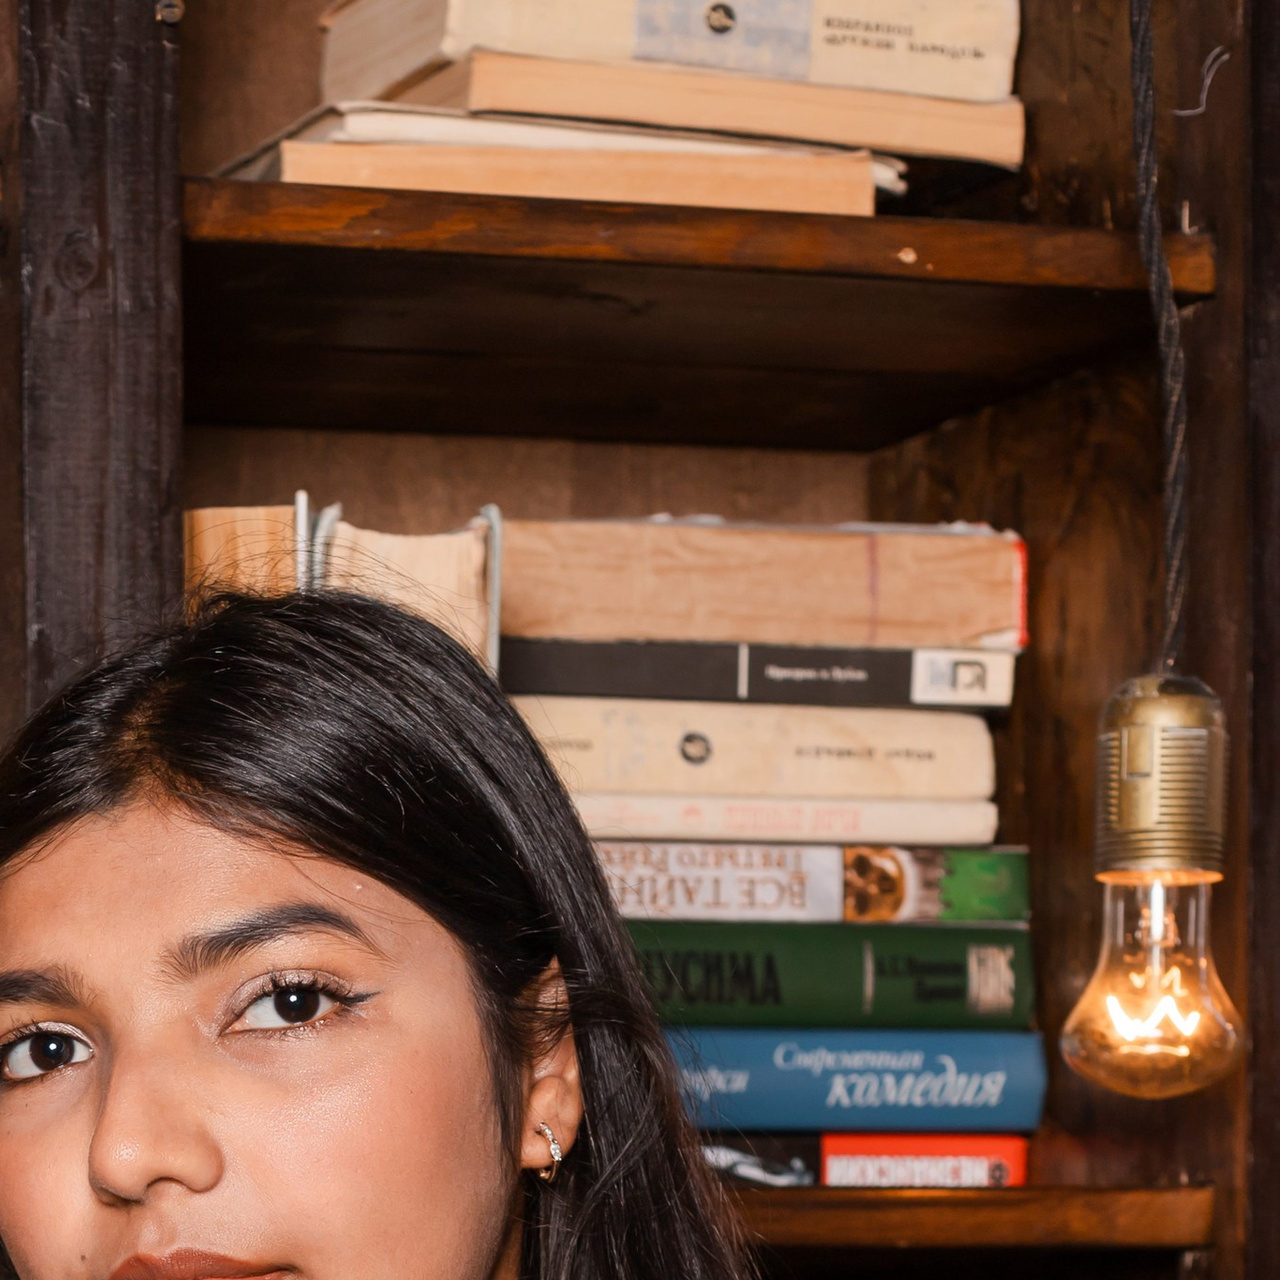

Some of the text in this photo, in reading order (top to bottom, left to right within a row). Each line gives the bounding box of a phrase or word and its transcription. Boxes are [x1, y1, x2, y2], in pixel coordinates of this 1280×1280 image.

[607, 873, 807, 912] ВСЕ ТАЙН
[644, 947, 782, 1006] УСИМА
[773, 1042, 925, 1074] Современная
[825, 1054, 1007, 1108] комедия
